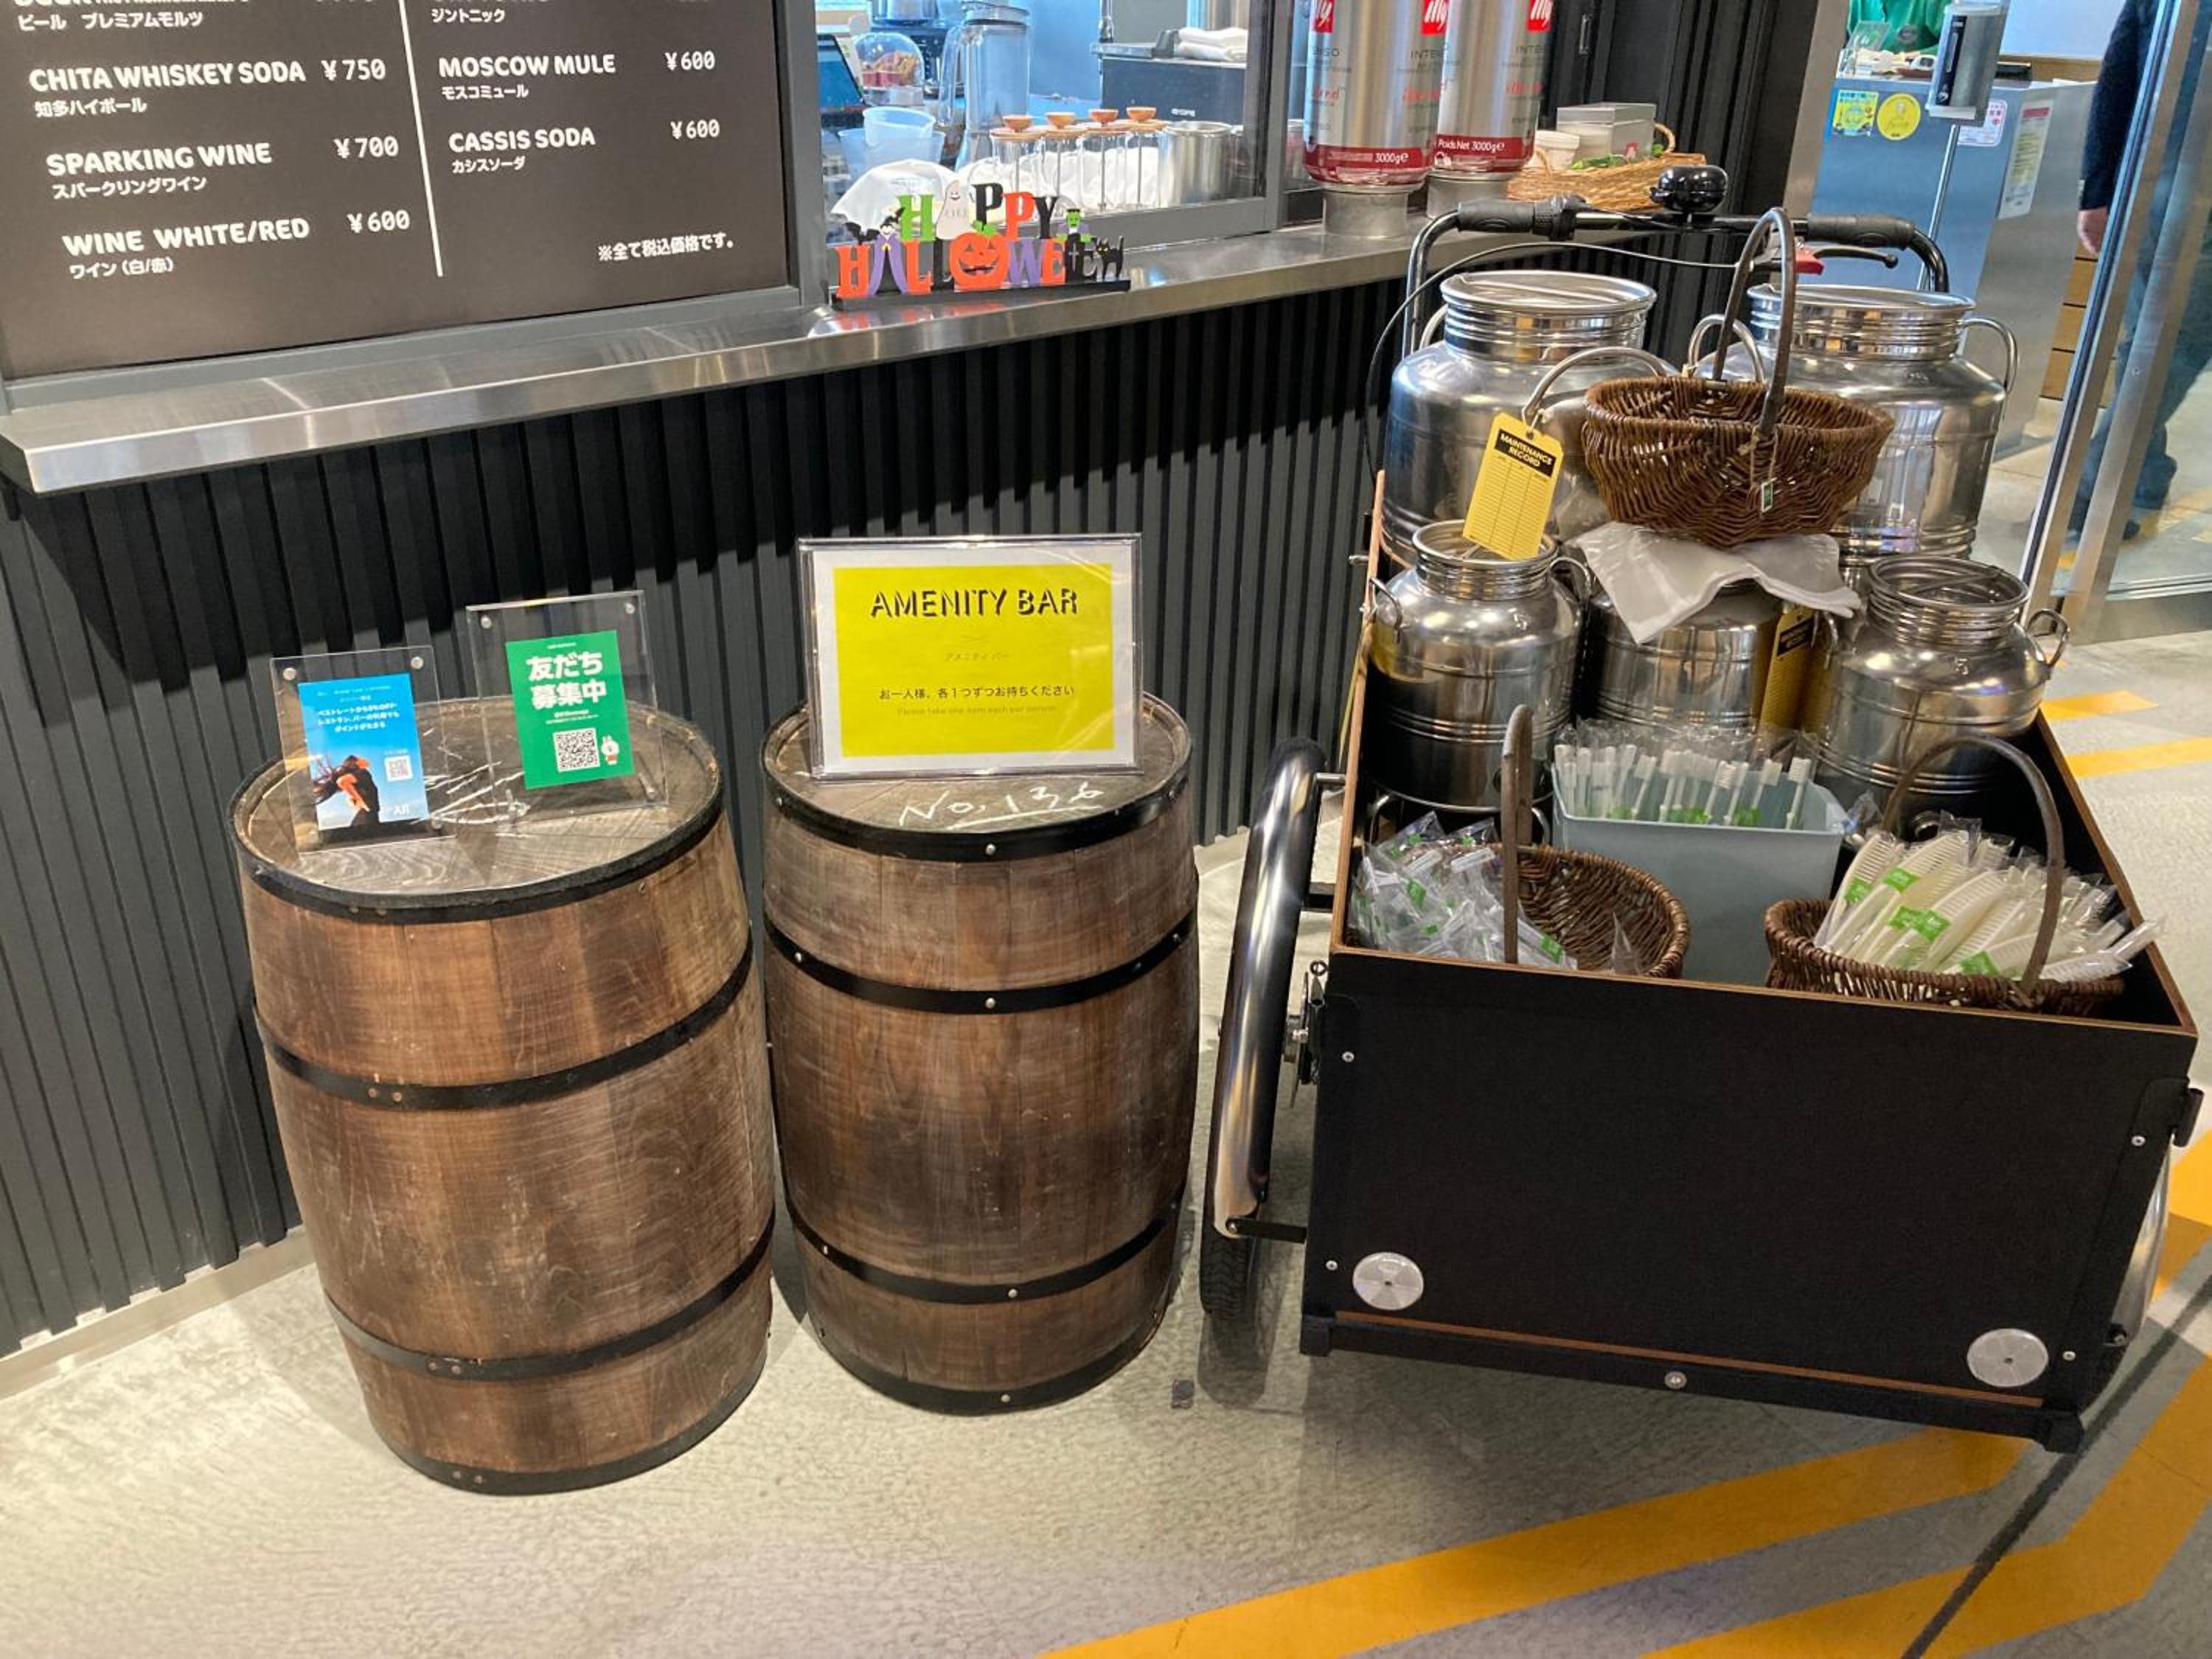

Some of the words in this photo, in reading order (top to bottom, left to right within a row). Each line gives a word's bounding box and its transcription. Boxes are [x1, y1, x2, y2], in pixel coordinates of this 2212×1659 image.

[17, 13, 67, 32] ビール
[81, 11, 204, 29] プレミアムモルツ
[431, 8, 505, 23] ジントニック
[29, 67, 114, 92] CHITA
[113, 63, 234, 89] WHISKEY
[237, 60, 306, 84] SODA
[439, 55, 549, 77] MOSCOW
[554, 54, 616, 74] MULE
[442, 84, 529, 100] モスコミュール
[34, 97, 147, 118] 知多ハイボール
[448, 129, 531, 153] CASSIS
[535, 127, 596, 148] SODA
[46, 147, 195, 177] SPARKING
[196, 142, 272, 167] WINE
[451, 156, 526, 174] カシスソーダ
[52, 175, 207, 200] スパークリングワイン
[899, 183, 1059, 241] HPPY
[61, 229, 145, 257] WINE
[153, 218, 310, 250] WHITE/RED
[598, 232, 734, 261] ※全て税込価格です。
[1500, 433, 1553, 466] MAINTENANCE
[1509, 446, 1540, 466] RECORD
[871, 588, 1007, 619] AMENITY
[1018, 588, 1078, 616] BAR
[526, 652, 603, 681] 友だち
[531, 678, 607, 710] 募集中
